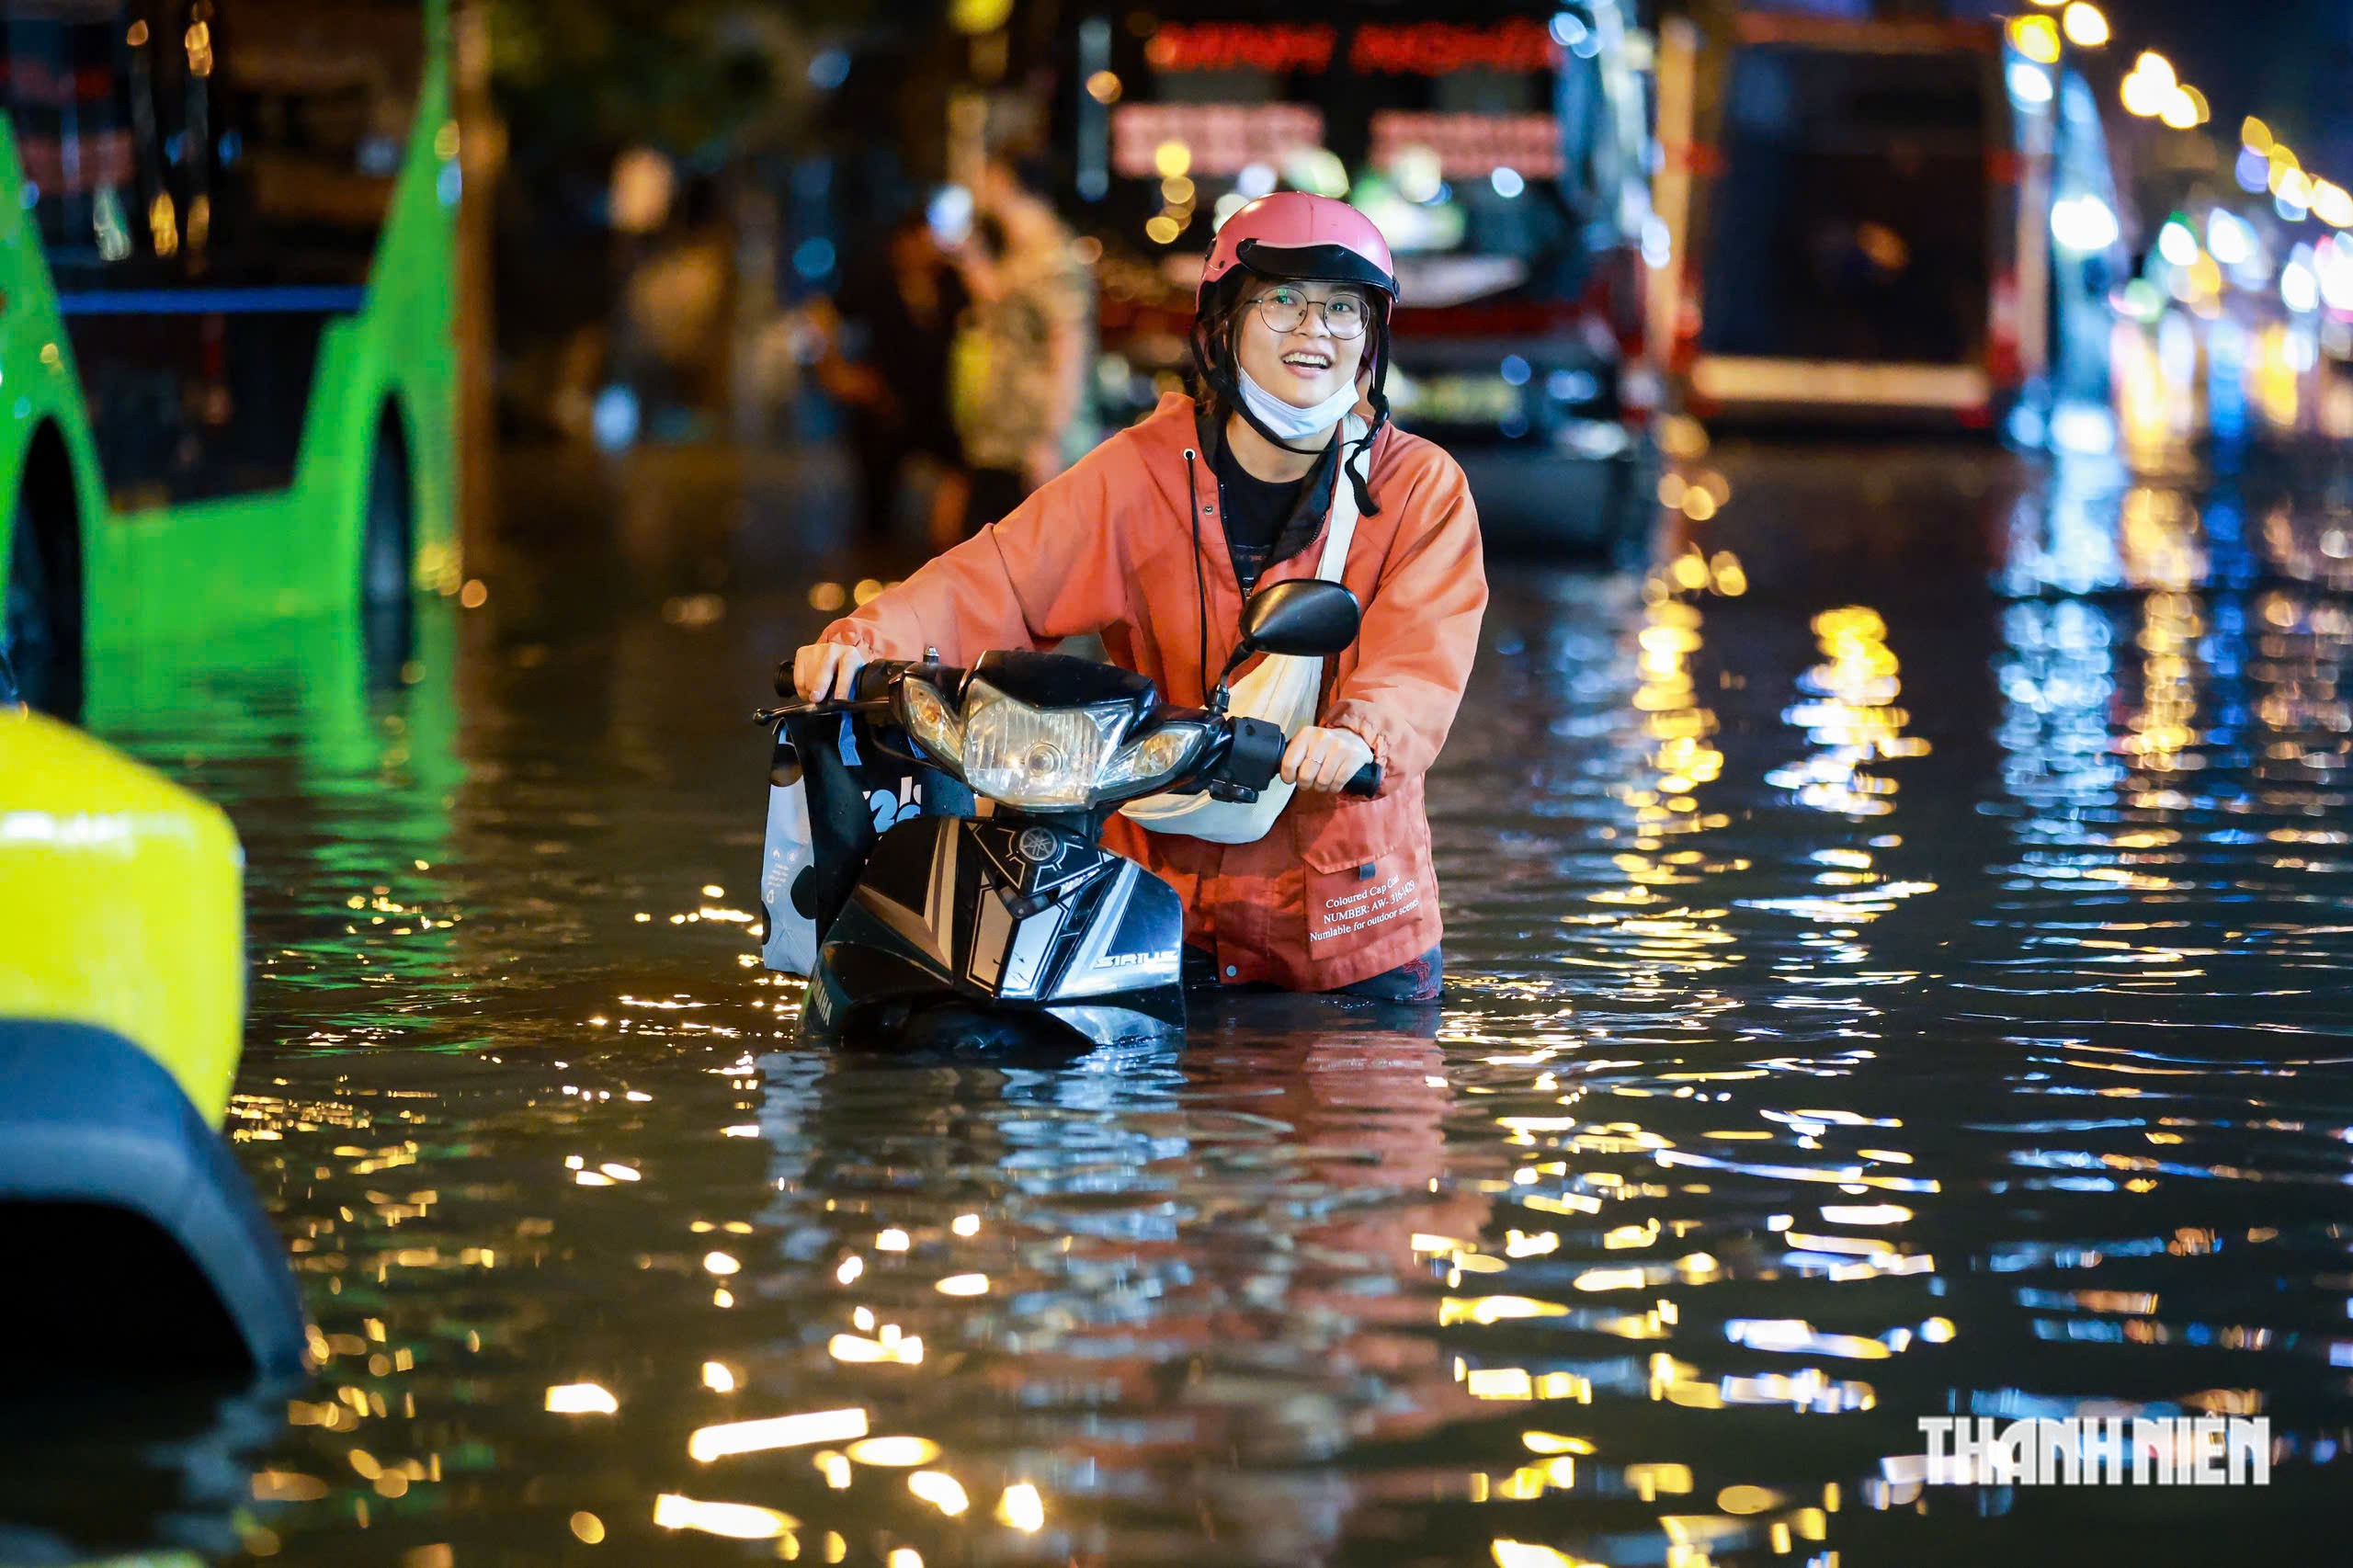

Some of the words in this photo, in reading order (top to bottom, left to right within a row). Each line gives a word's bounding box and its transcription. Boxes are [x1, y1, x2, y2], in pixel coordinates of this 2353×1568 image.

[1325, 890, 1368, 908] Coloured
[1370, 885, 1387, 896] Cap
[1324, 905, 1370, 924] NUMBER:
[1371, 898, 1389, 912] AW-
[1353, 920, 1367, 932] for
[1367, 910, 1397, 926] outdoor
[1093, 950, 1178, 969] SIRIUS
